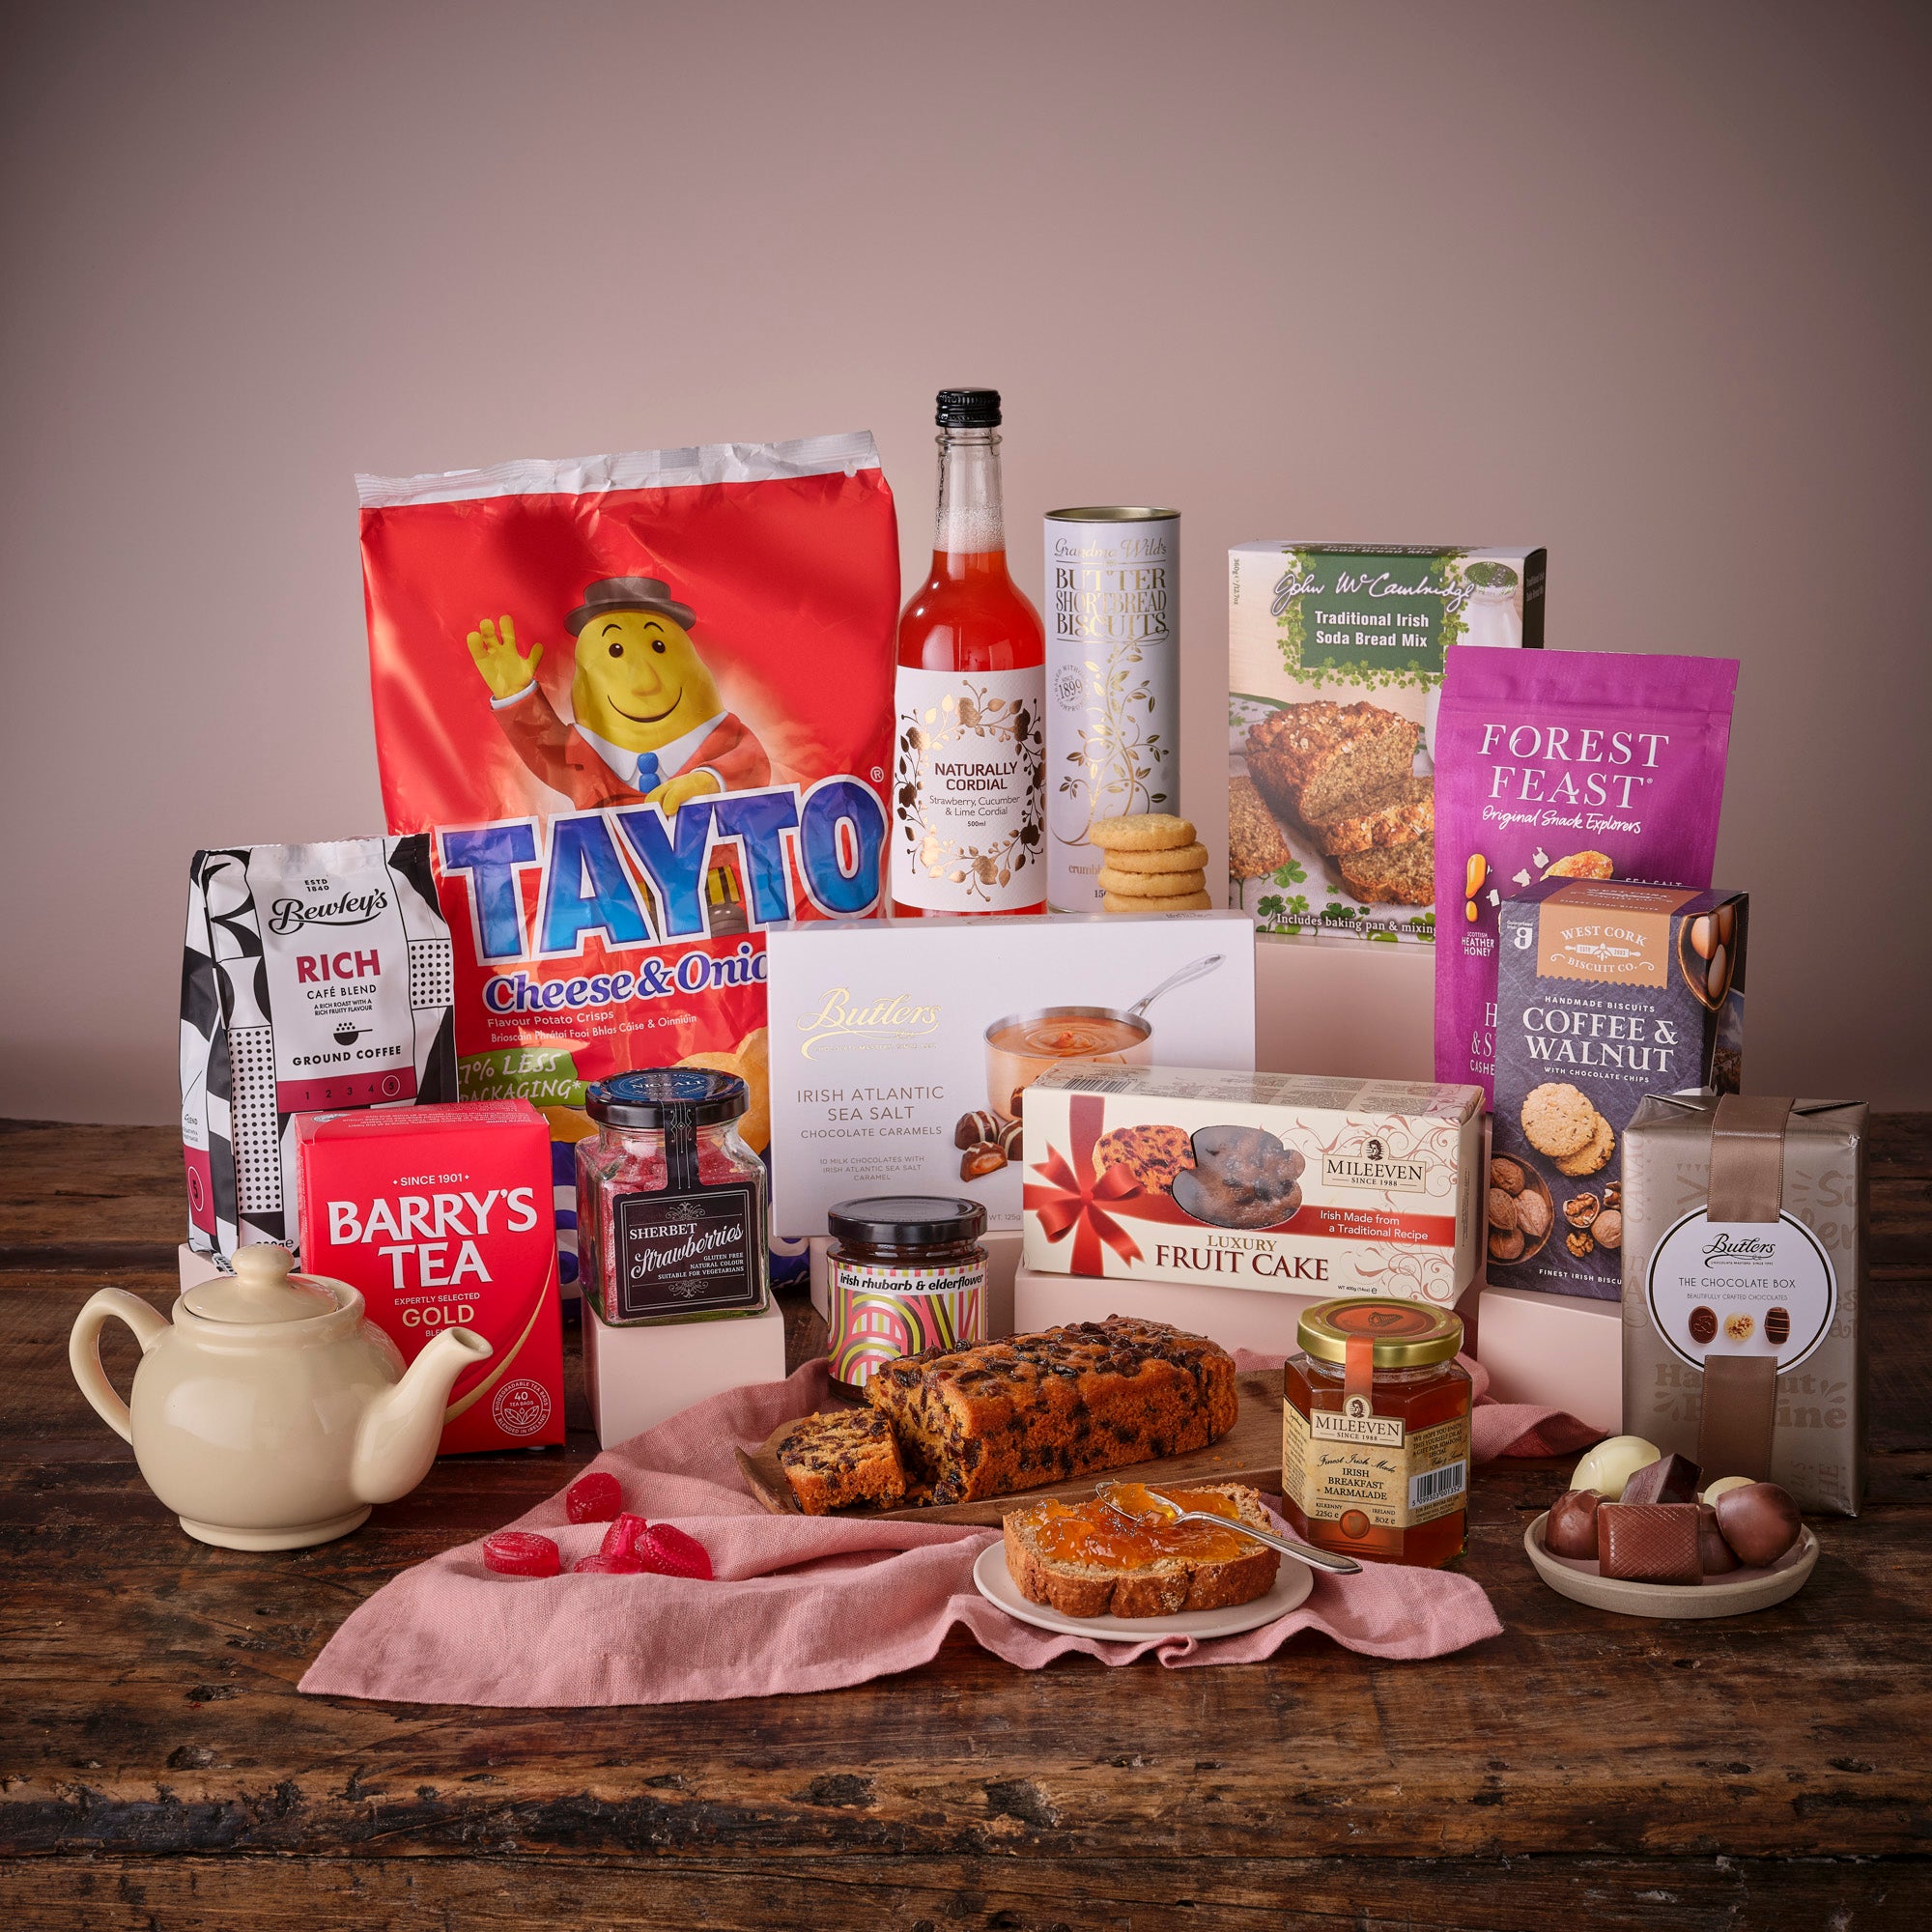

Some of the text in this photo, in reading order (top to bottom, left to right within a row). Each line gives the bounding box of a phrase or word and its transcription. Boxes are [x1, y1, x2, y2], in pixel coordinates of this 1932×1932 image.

[1054, 538, 1167, 557] Grandma Wild's
[1056, 568, 1166, 591] BUTTER
[1056, 589, 1167, 614] SHORTBREAD
[1271, 574, 1325, 615] John
[1057, 612, 1168, 638] BISCUITS
[1315, 611, 1430, 628] Traditional Irish
[1316, 631, 1428, 648] Soda Bread Mix
[1059, 679, 1083, 698] 1899
[1477, 724, 1669, 768] FOREST
[935, 762, 1017, 776] NATURALLY
[946, 779, 1008, 791] CORDIAL
[1488, 765, 1644, 810] FEAST
[929, 795, 1020, 808] Strawberry, Cucumber
[945, 806, 1008, 816] & Lime Cordial
[1483, 805, 1641, 835] Original Snack Explorers
[436, 775, 889, 965] TAYTO
[269, 888, 388, 935] Bewley's
[1276, 913, 1322, 926] Includes
[1325, 919, 1362, 932] baking
[1366, 922, 1385, 934] pan
[1388, 922, 1398, 931] &
[1461, 937, 1494, 948] HEATHER
[1560, 925, 1648, 948] WEST CORK
[1463, 947, 1492, 957] HONEY
[296, 949, 382, 984] RICH
[1568, 956, 1637, 973] BISCUIT CO.
[306, 984, 377, 1000] CAFÉ BLEND
[484, 971, 634, 1011] Cheese
[796, 987, 942, 1032] Butlers
[1545, 995, 1655, 1013] HANDMADE BISCUITS
[487, 1011, 614, 1028] Flavour Potato Crisps
[1522, 1007, 1679, 1046] COFFEE &
[491, 1031, 531, 1043] Brioscáin
[569, 1028, 589, 1038] Faoi
[592, 1024, 617, 1037] Bhlas
[618, 1021, 644, 1034] Cáise
[293, 1045, 402, 1066] GROUND COFFEE
[1524, 1035, 1675, 1072] WALNUT
[502, 1053, 560, 1075] LESS
[1544, 1065, 1650, 1084] WITH CHOCOLATE CHIPS
[797, 1086, 945, 1103] IRISH ATLANTIC
[828, 1106, 915, 1122] SEA SALT
[801, 1126, 942, 1139] CHOCOLATE CARAMELS
[850, 1156, 902, 1165] CHOCOLATES
[1326, 1158, 1424, 1181] MILEEVEN
[400, 1173, 463, 1187] SINCE 1901
[1350, 1177, 1399, 1187] SINCE 1988
[327, 1187, 539, 1246] BARRY'S
[1321, 1209, 1400, 1226] Irish Made from
[629, 1223, 697, 1240] SHERBET
[1338, 1224, 1391, 1237] Traditional
[1394, 1229, 1429, 1241] Recipe
[630, 1223, 744, 1280] Strawberries
[1208, 1235, 1278, 1252] LUXURY
[1702, 1233, 1776, 1254] Butlers
[378, 1239, 494, 1290] TEA
[690, 1259, 744, 1269] NATURAL COLOUR
[703, 1251, 744, 1262] GLUTEN FREE
[1155, 1244, 1329, 1282] FRUIT CAKE
[658, 1271, 688, 1281] SUITABLE
[702, 1265, 745, 1276] VEGETARIANS
[839, 1272, 983, 1292] irish rhubarb & elderflower
[1539, 1268, 1568, 1278] FINEST
[1572, 1272, 1595, 1282] IRISH
[1679, 1277, 1796, 1289] THE CHOCOLATE BOX
[394, 1293, 480, 1306] EXPERTLY SELECTED
[402, 1304, 475, 1327] GOLD
[495, 1381, 529, 1411] BIODEGRADABLE
[515, 1391, 528, 1401] 40
[497, 1417, 520, 1434] BLENDED
[527, 1413, 547, 1433] IRELAND
[1315, 1415, 1401, 1436] MILEEVEN
[1318, 1453, 1396, 1473] Finest Irish Made
[1343, 1467, 1370, 1478] IRISH
[1328, 1476, 1384, 1490] BREAKFAST
[1324, 1487, 1387, 1500] MARMALADE
